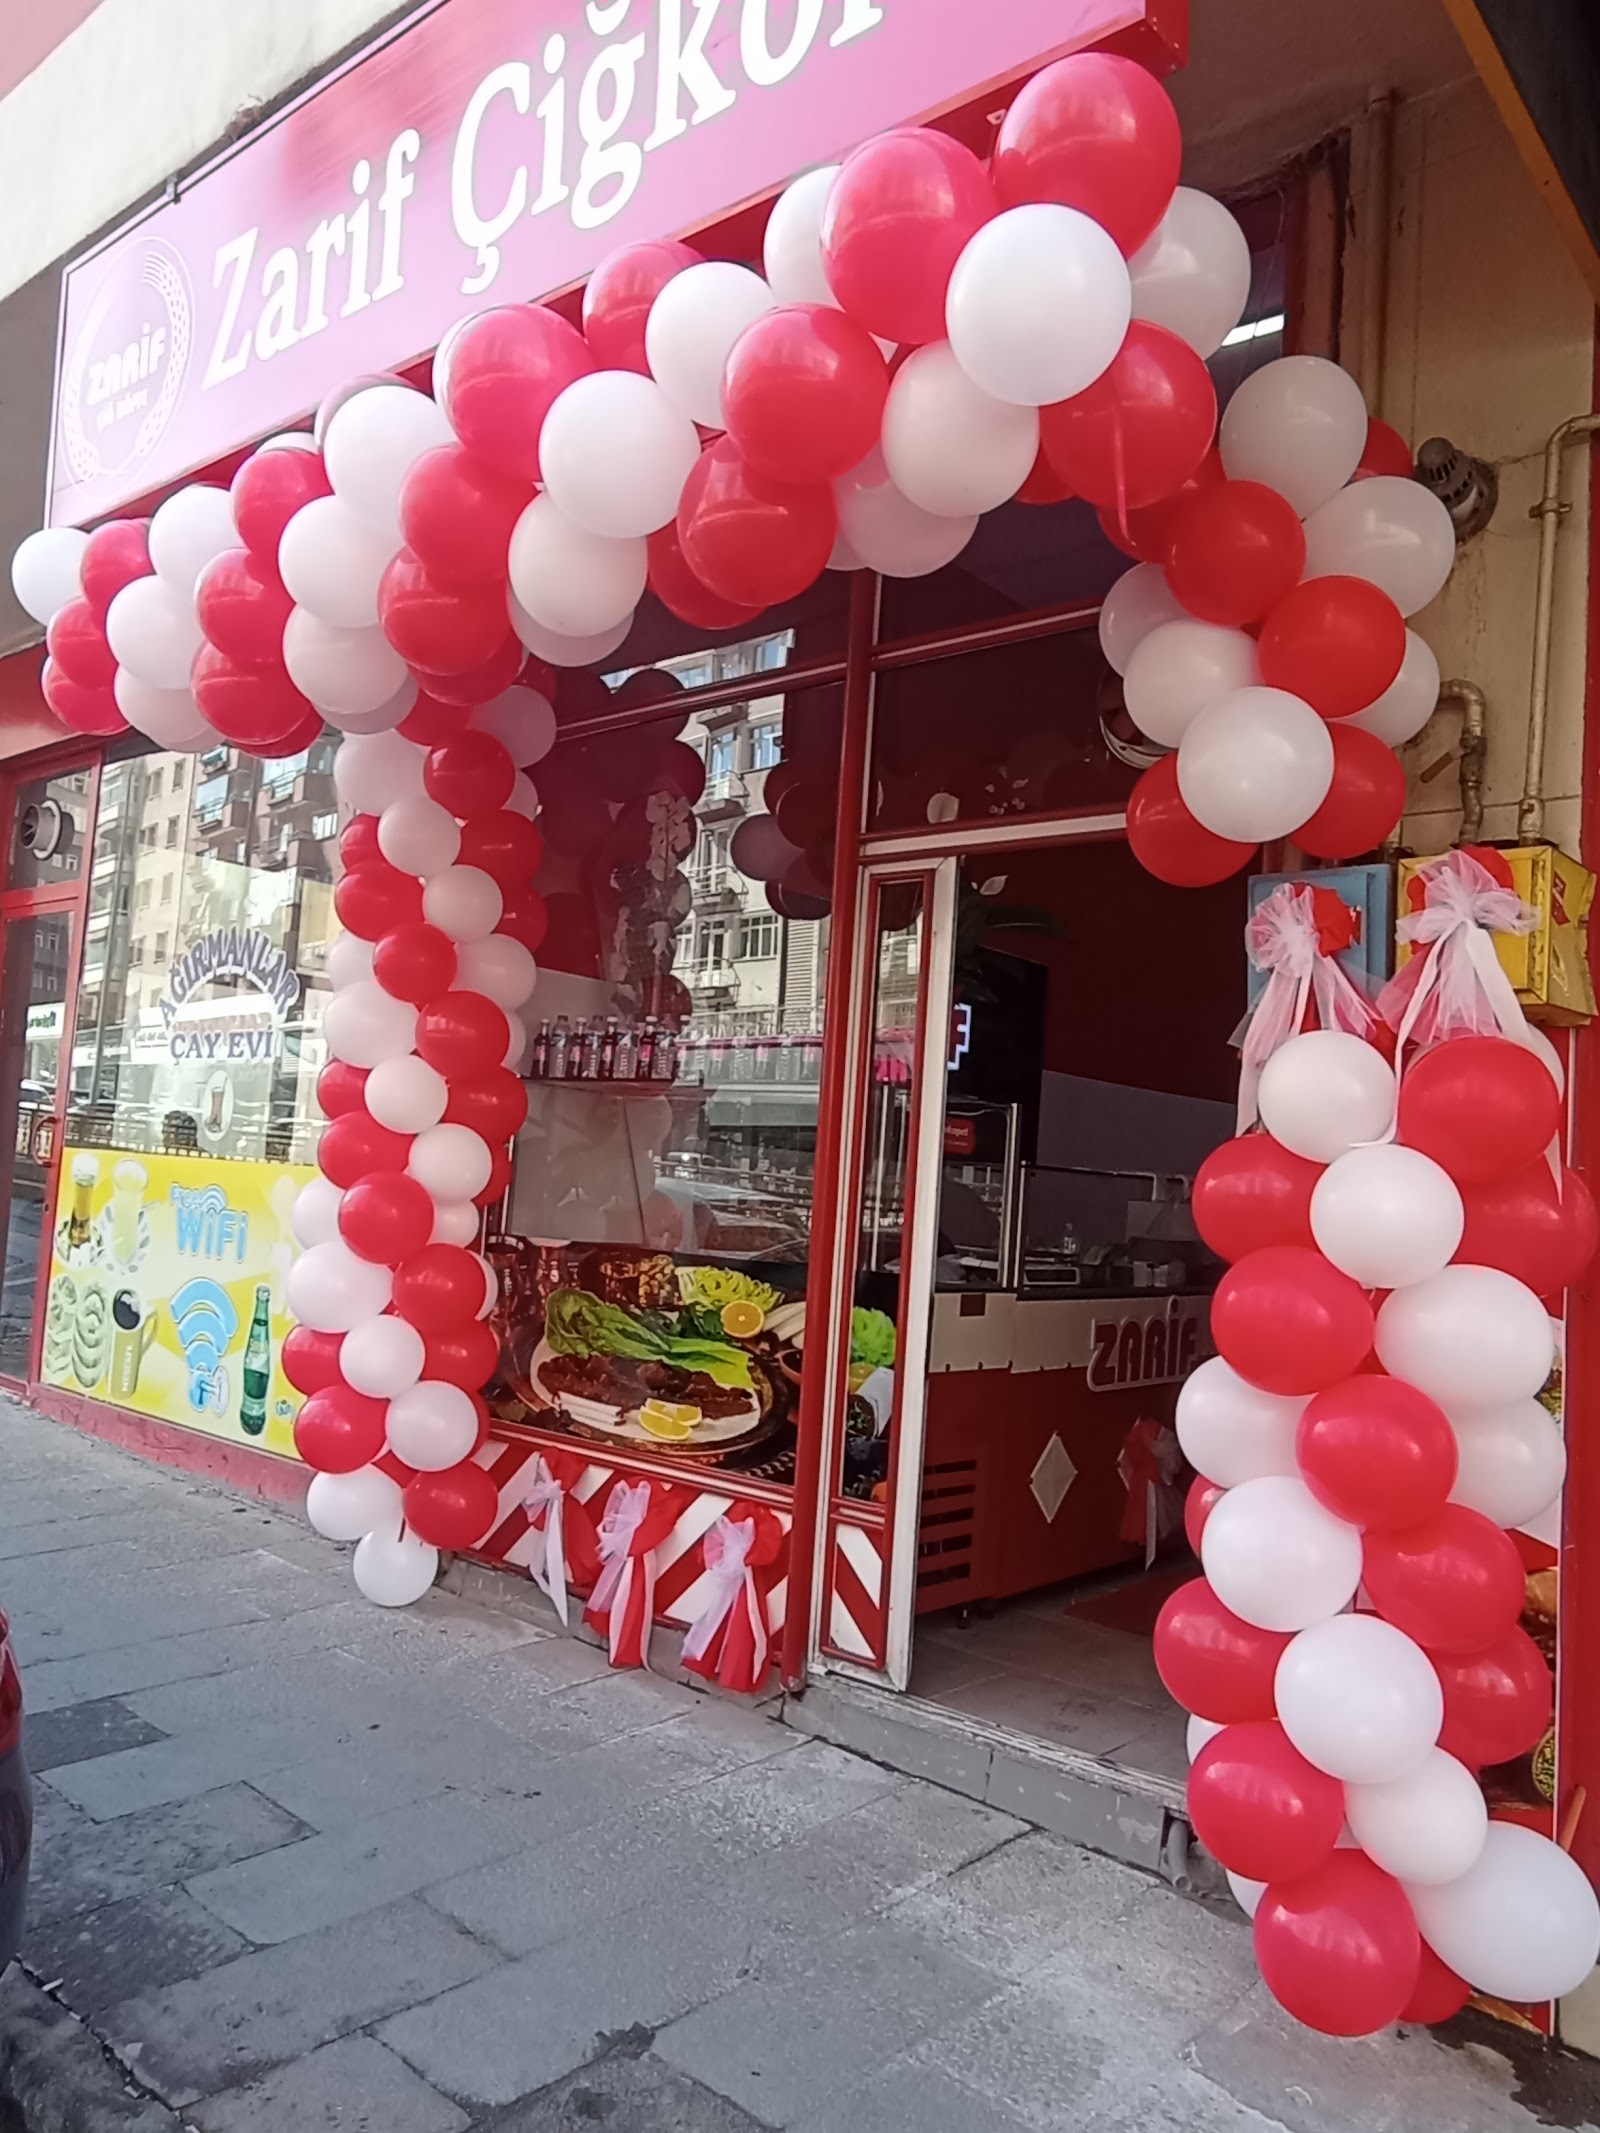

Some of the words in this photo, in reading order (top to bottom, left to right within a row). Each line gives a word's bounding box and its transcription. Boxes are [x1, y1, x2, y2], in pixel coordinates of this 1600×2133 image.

[201, 128, 420, 392] Zarif
[170, 1032, 222, 1066] ÇAY
[227, 1024, 274, 1059] EVİ
